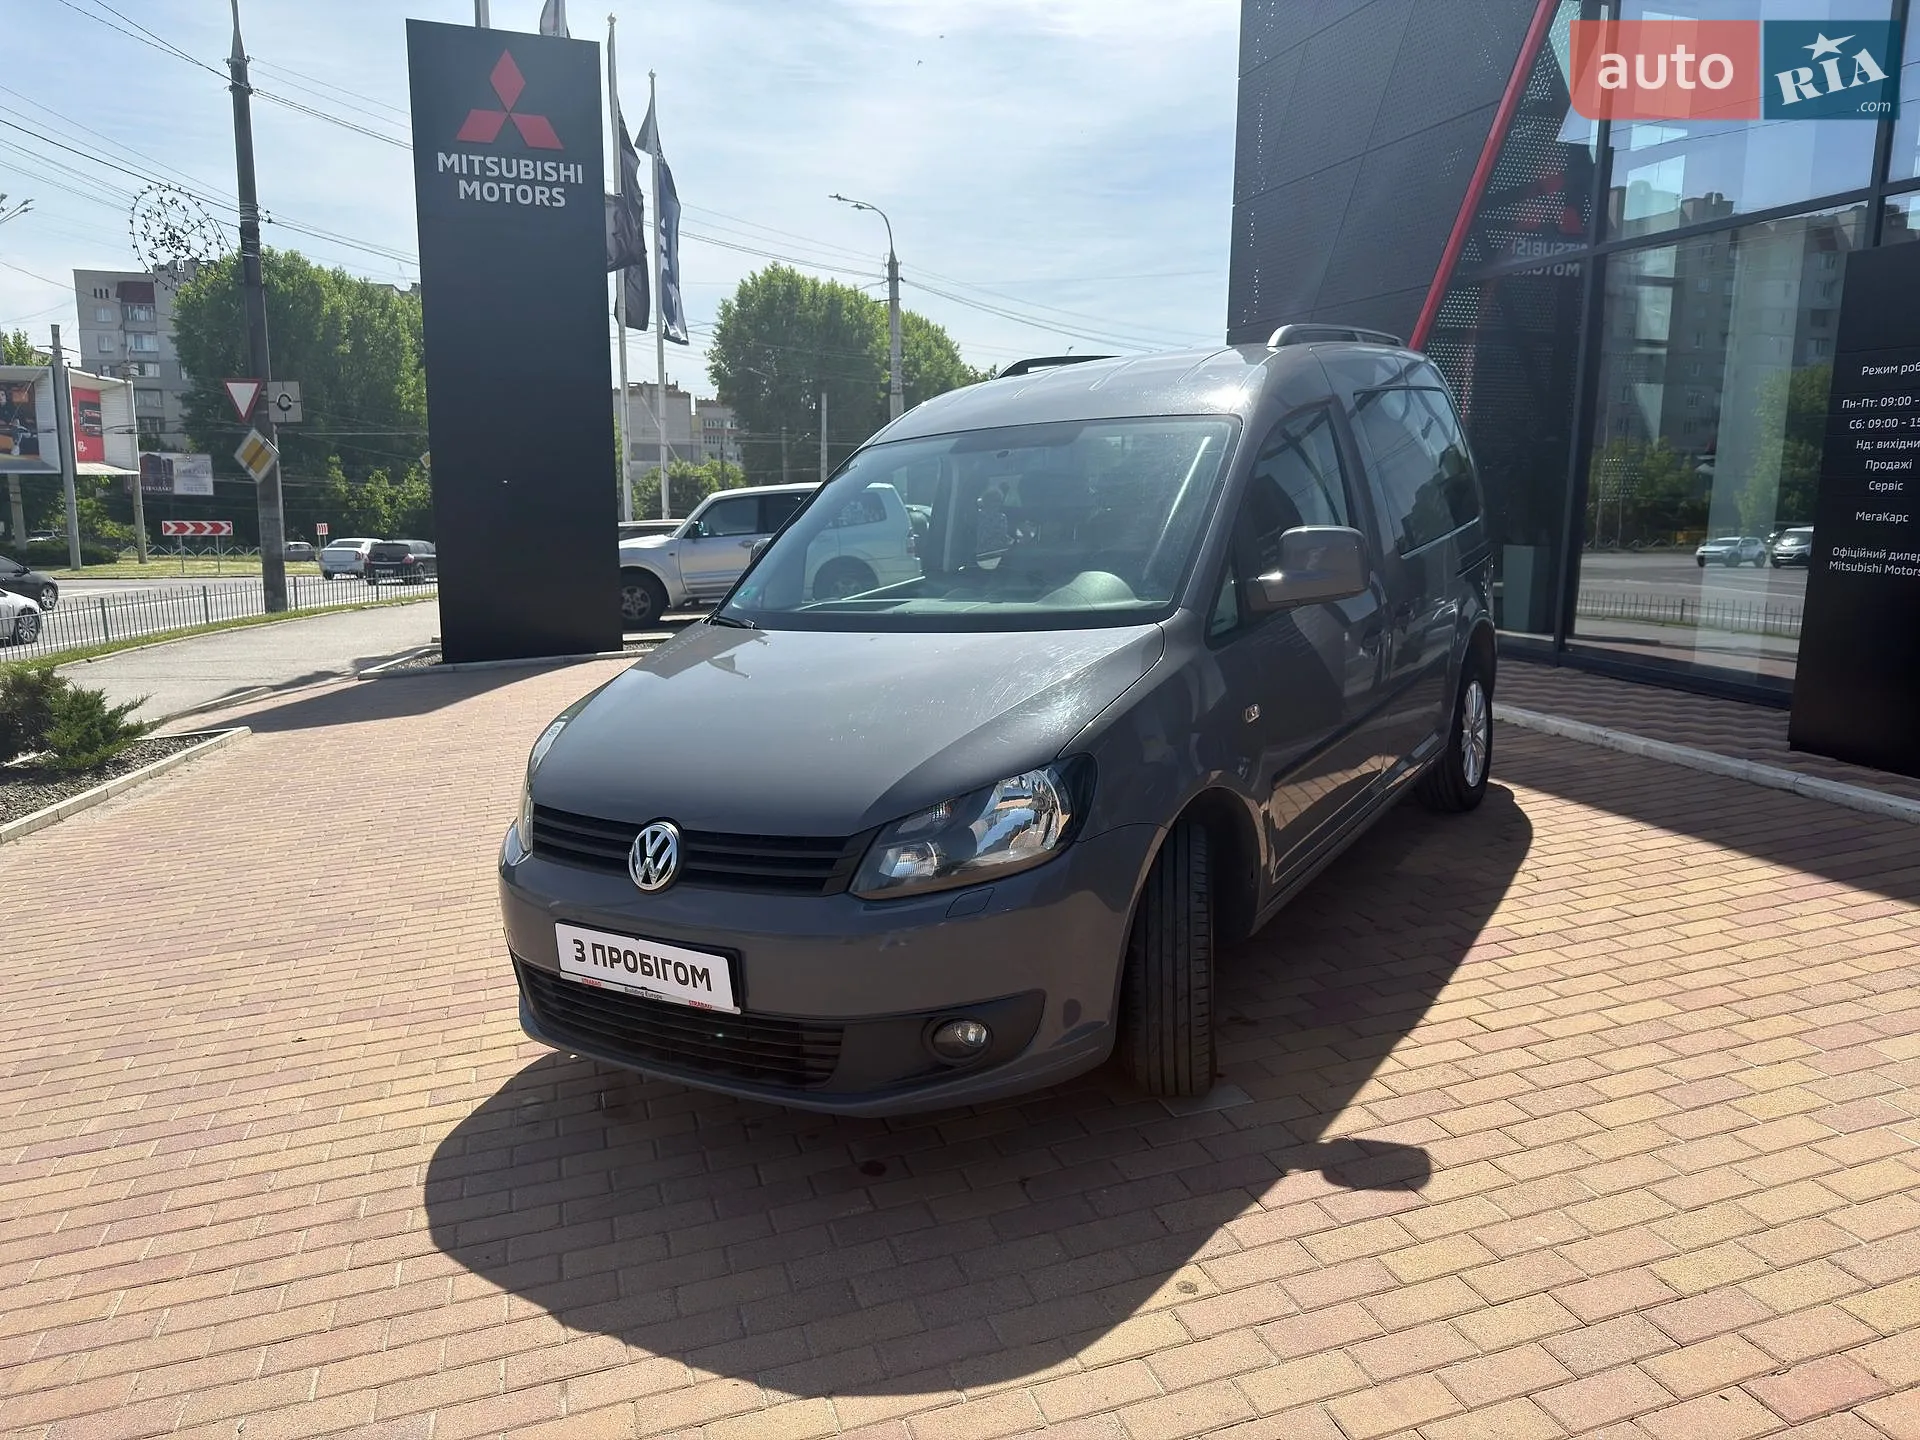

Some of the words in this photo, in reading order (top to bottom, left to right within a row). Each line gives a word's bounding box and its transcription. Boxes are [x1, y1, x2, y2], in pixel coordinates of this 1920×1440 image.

[437, 151, 584, 184] MITSUBISHI
[458, 179, 566, 208] MOTORS
[1861, 365, 1898, 376] Режим
[1842, 398, 1878, 409] Пн-Пт:
[1880, 396, 1912, 407] 09:00
[1849, 419, 1866, 430] Сб:
[1868, 418, 1899, 429] 09:00
[1856, 439, 1874, 451] Нд:
[1865, 459, 1913, 471] Продажі
[1868, 480, 1904, 493] Сервіс
[1855, 511, 1909, 524] МегаКарс
[1832, 547, 1887, 559] Офіційний
[1829, 560, 1882, 574] Mitsubishi
[591, 942, 713, 992] ПРОБІГОМ
